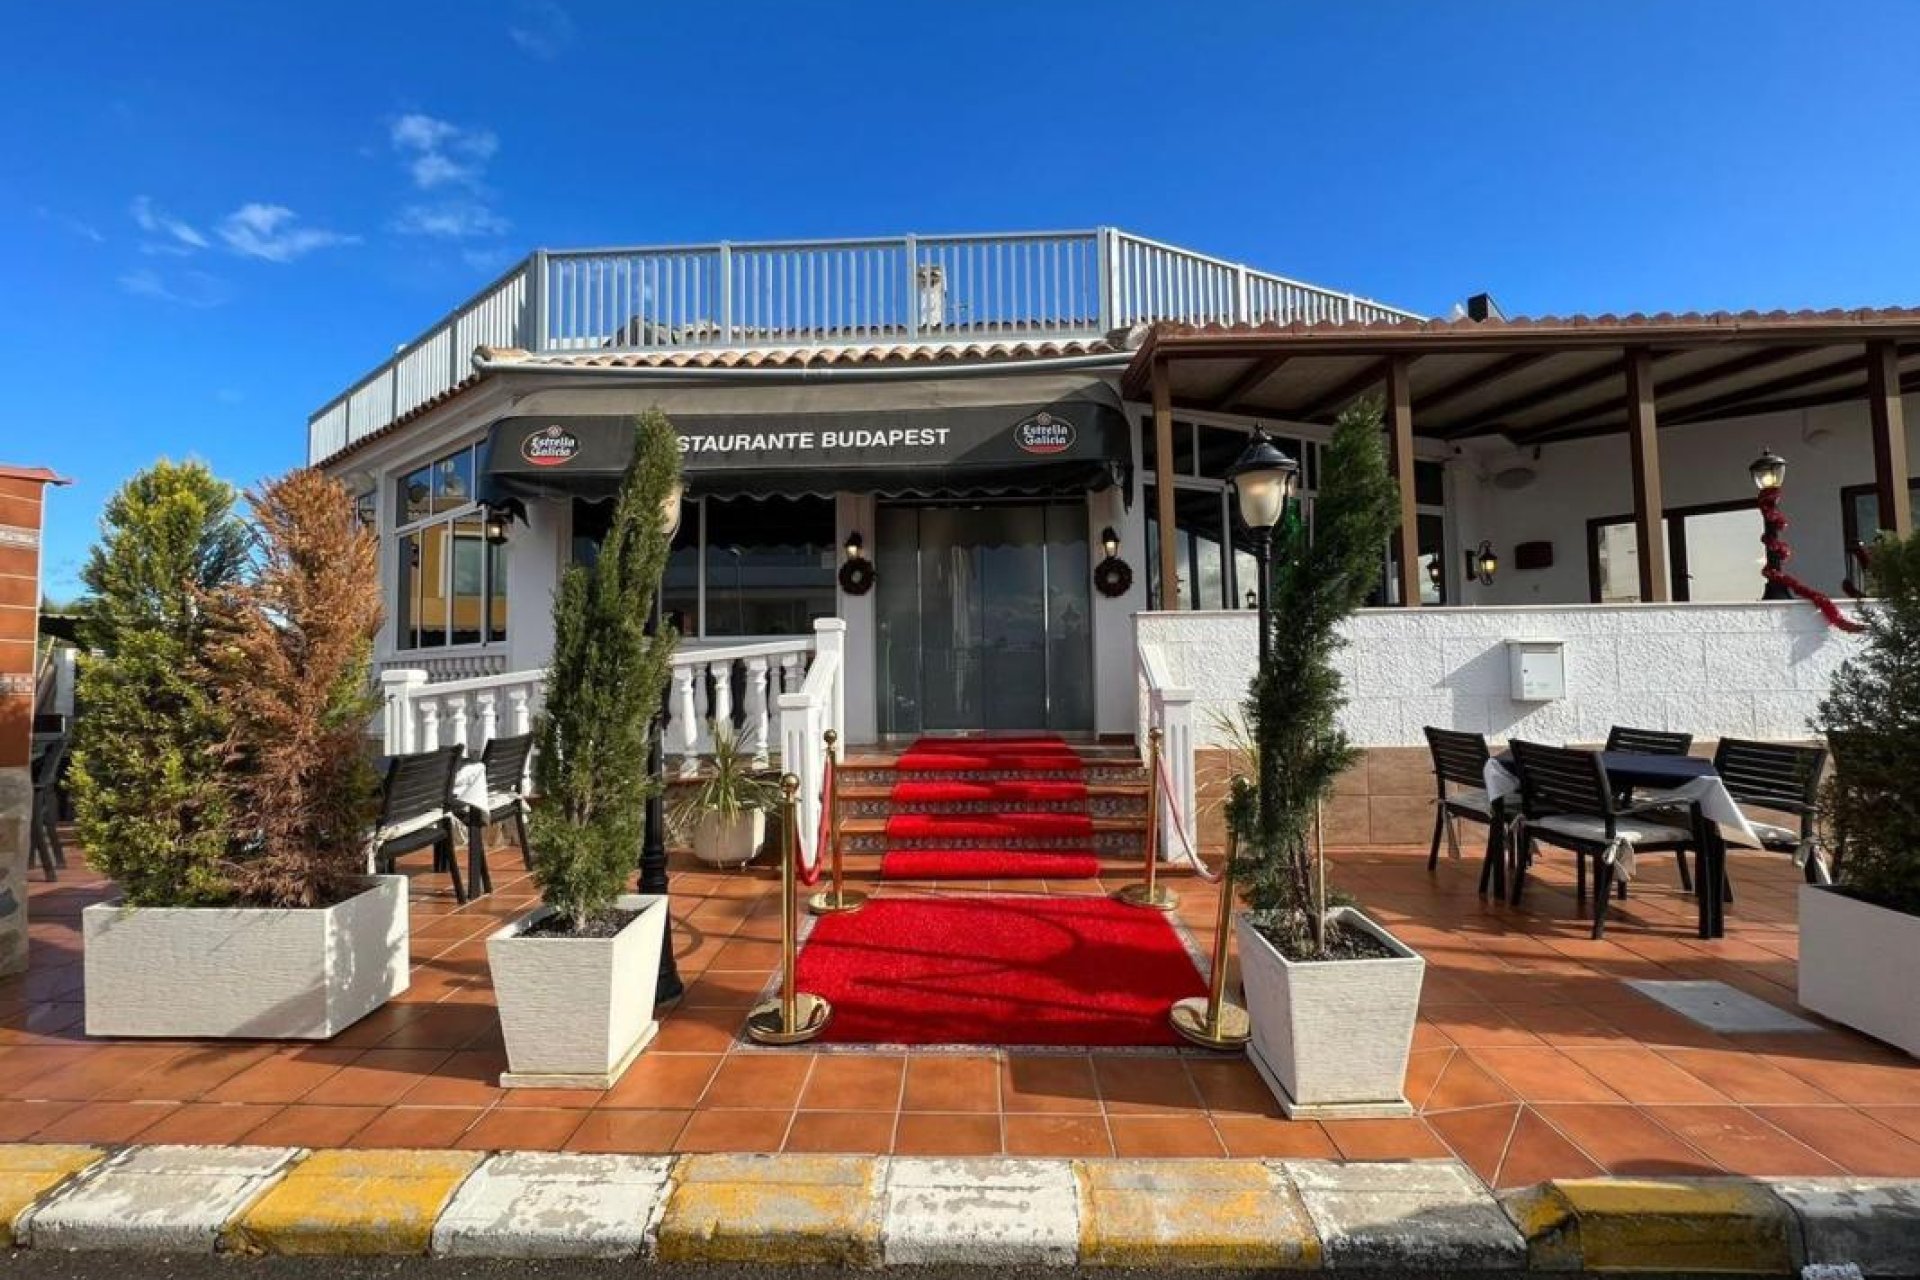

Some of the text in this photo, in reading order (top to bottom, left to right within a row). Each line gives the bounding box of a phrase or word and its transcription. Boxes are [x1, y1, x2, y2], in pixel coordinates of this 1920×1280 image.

[1023, 424, 1067, 435] Estrella
[531, 436, 575, 448] Estrella
[676, 427, 951, 453] STAURANTE BUDAPEST
[1024, 434, 1066, 445] Galicia
